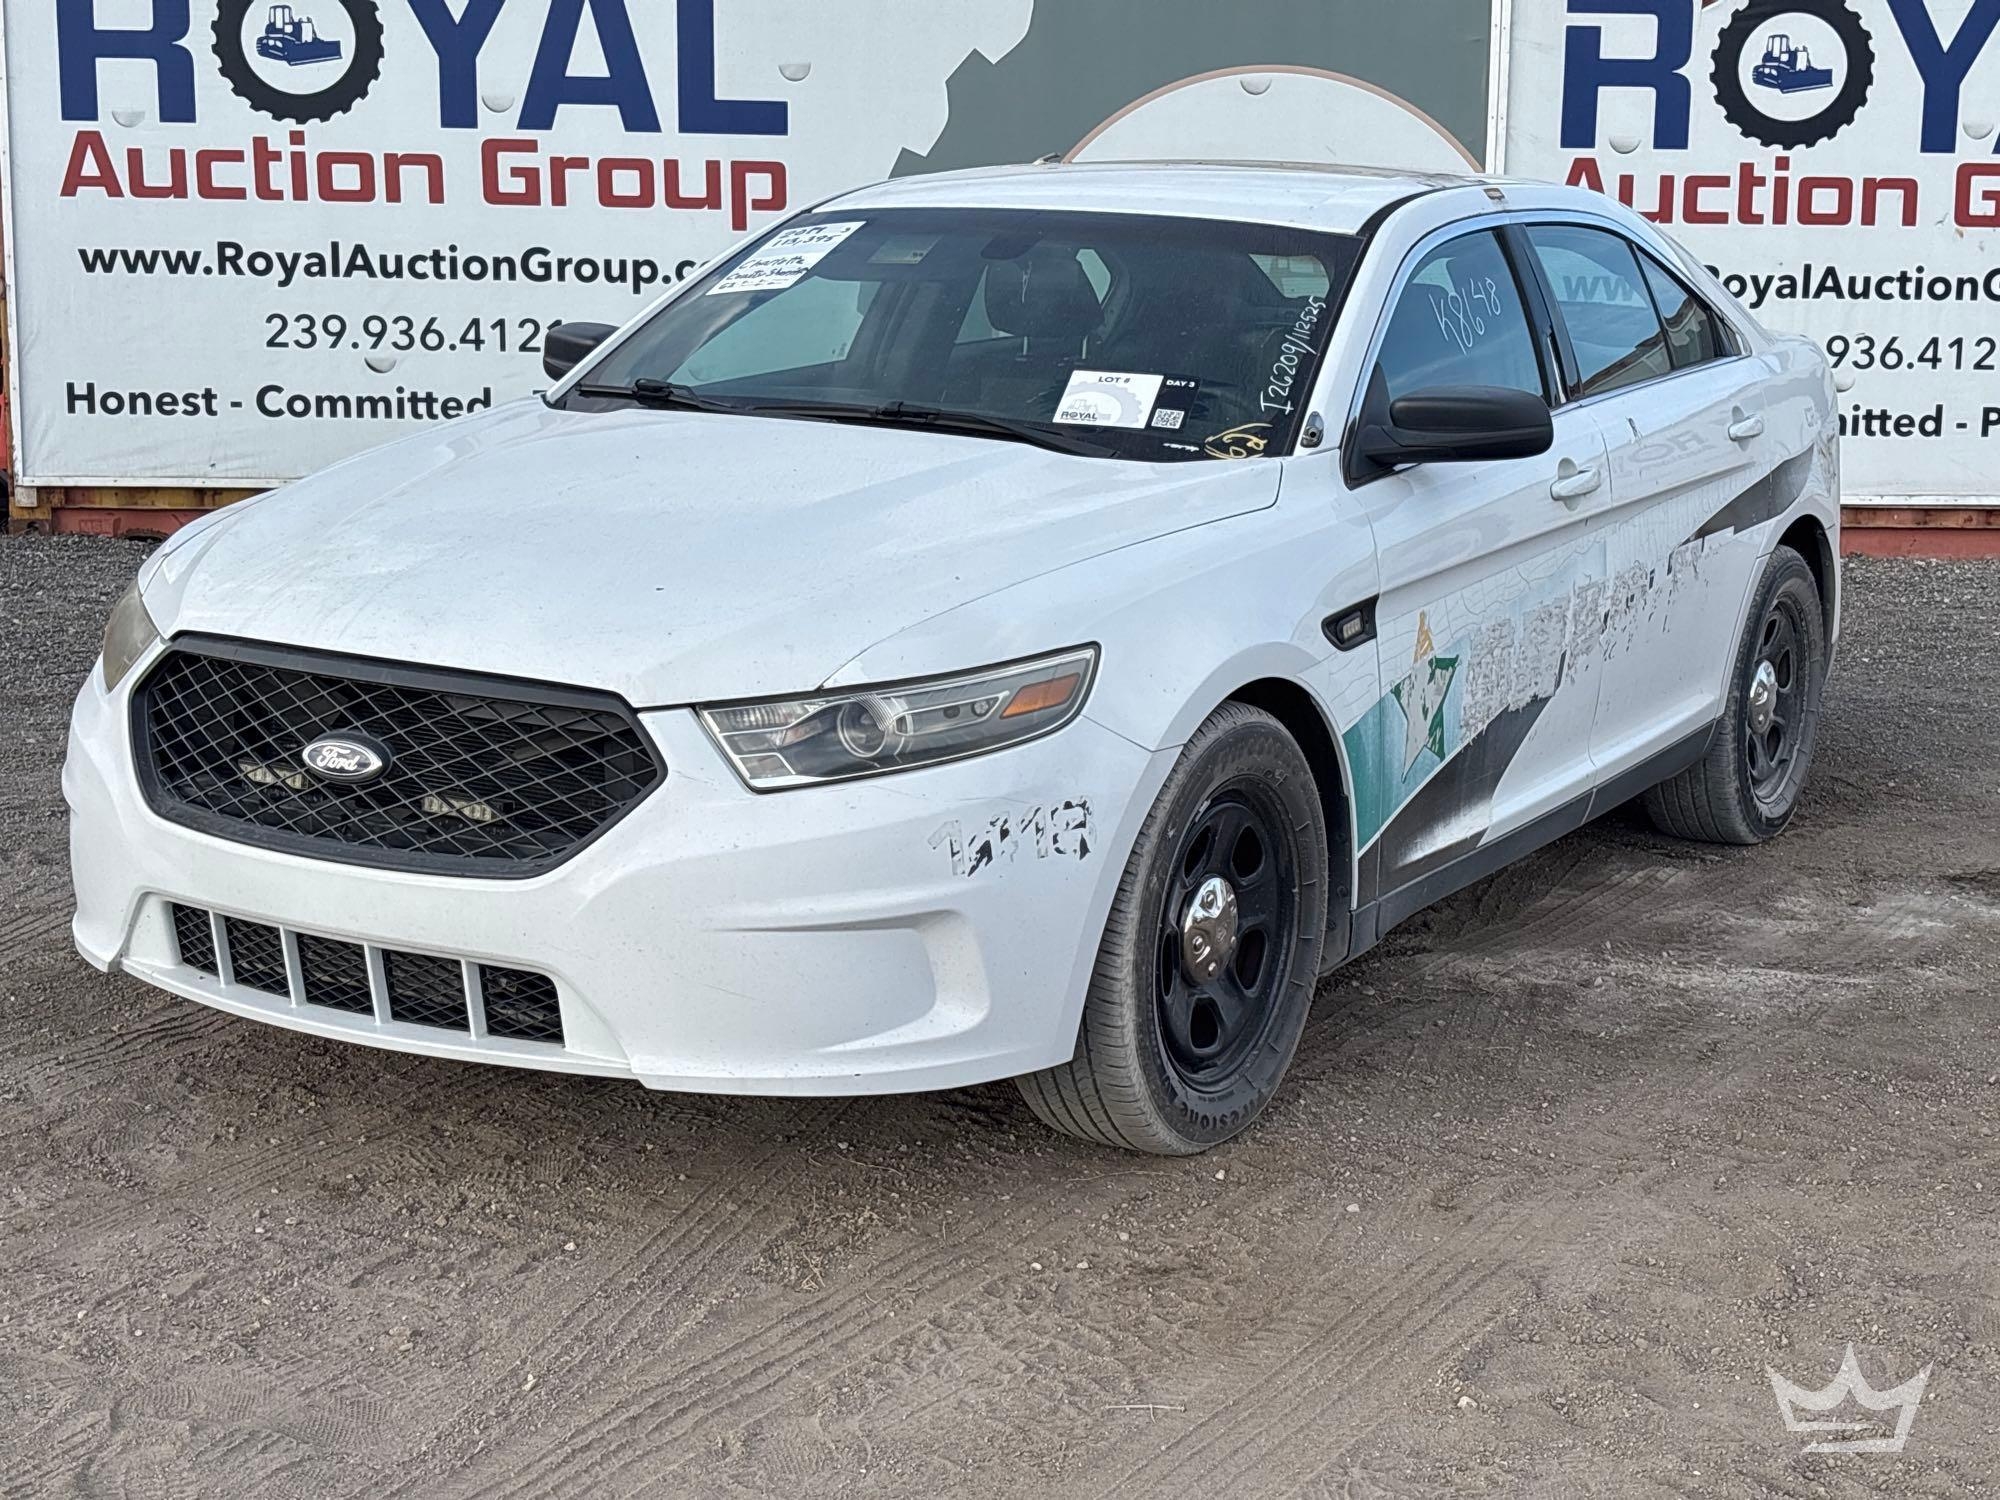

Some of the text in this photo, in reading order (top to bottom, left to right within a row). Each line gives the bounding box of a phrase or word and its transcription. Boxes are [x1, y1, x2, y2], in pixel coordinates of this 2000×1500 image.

[1559, 0, 2000, 155] ROY
[60, 130, 788, 232] Auction Group
[78, 240, 711, 296] www.RoyalAuctionGroup.c
[265, 313, 563, 353] 239.936.412
[1428, 275, 1502, 356] K8648
[1098, 376, 1121, 384] LOT
[66, 382, 219, 417] Honest
[255, 386, 492, 421] Committed
[1060, 410, 1098, 420] ROYAL
[315, 746, 359, 771] Ford
